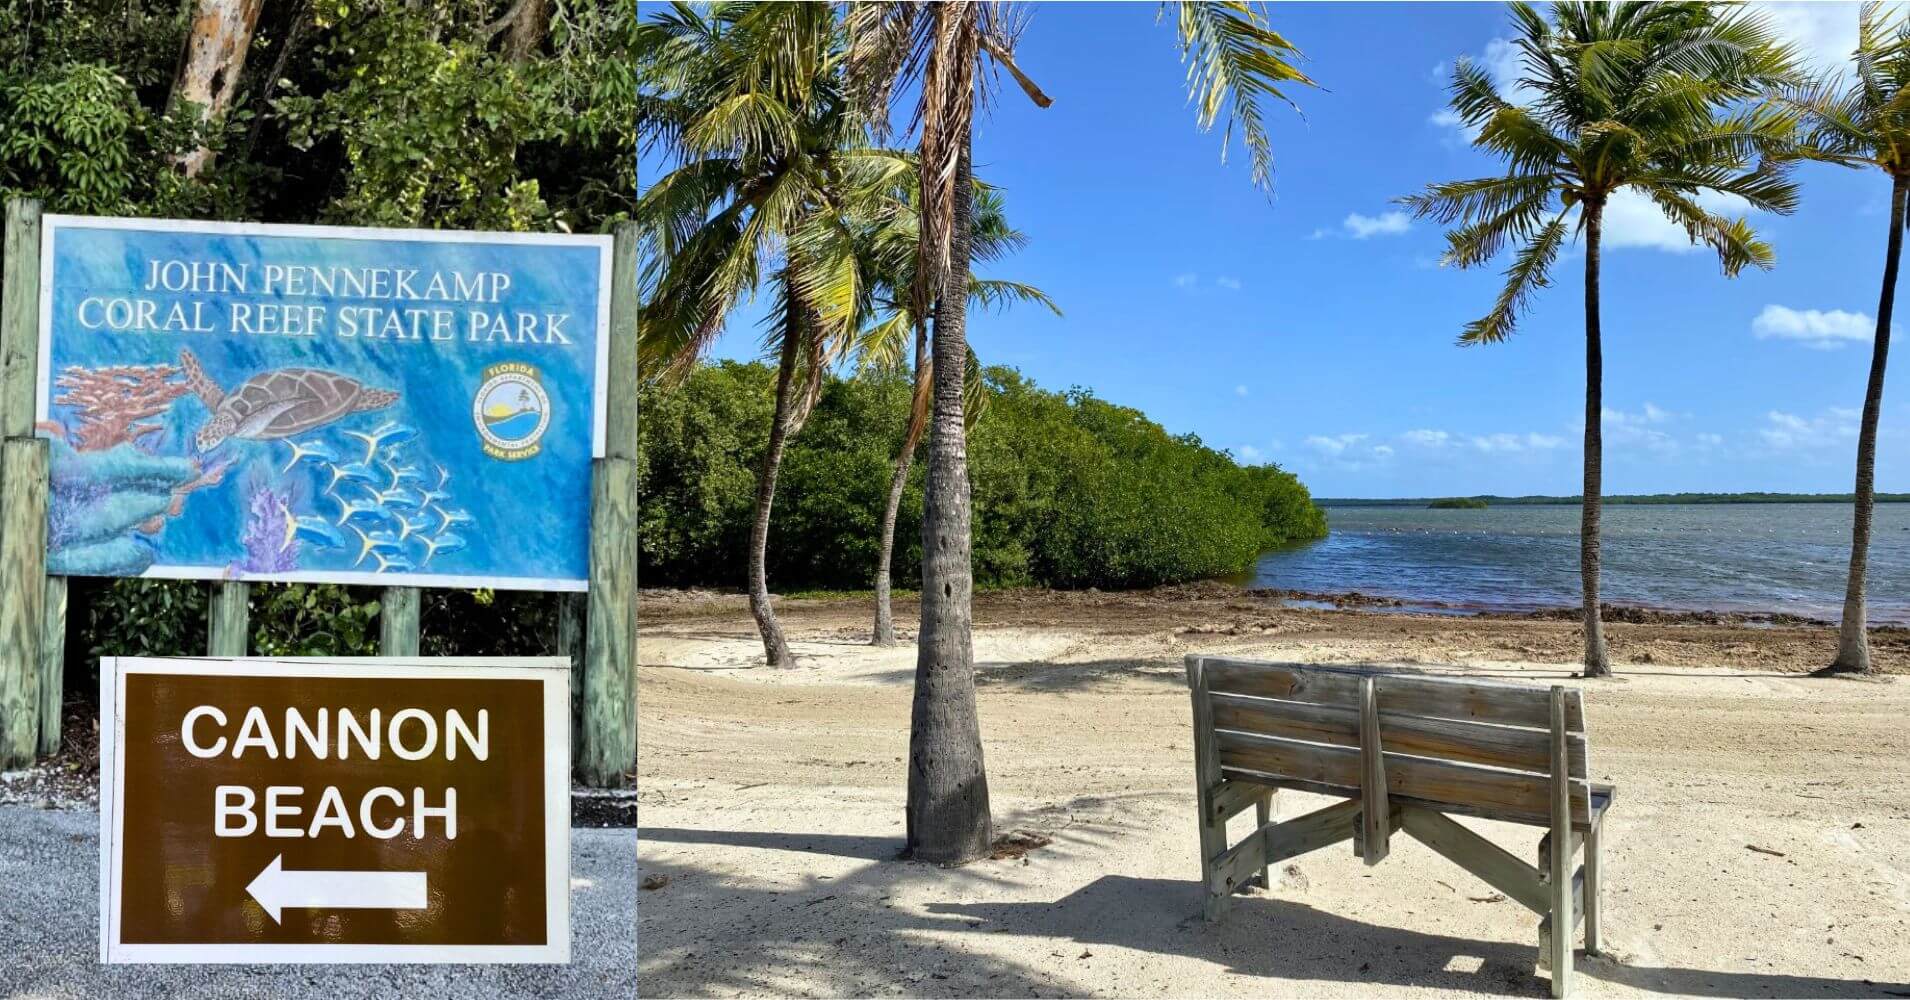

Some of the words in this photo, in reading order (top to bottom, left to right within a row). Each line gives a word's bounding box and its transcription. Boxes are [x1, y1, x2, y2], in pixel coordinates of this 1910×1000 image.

[145, 259, 247, 296] JOHN
[264, 264, 511, 302] PENNEKAMP
[78, 298, 214, 333] CORAL
[230, 302, 326, 336] REEF
[338, 306, 453, 341] STATE
[468, 311, 573, 346] PARK
[489, 364, 534, 376] FLORIDA
[485, 444, 504, 457] PARK
[508, 445, 539, 458] SERVICE
[181, 705, 489, 761] CANNON
[214, 785, 458, 840] BEACH
